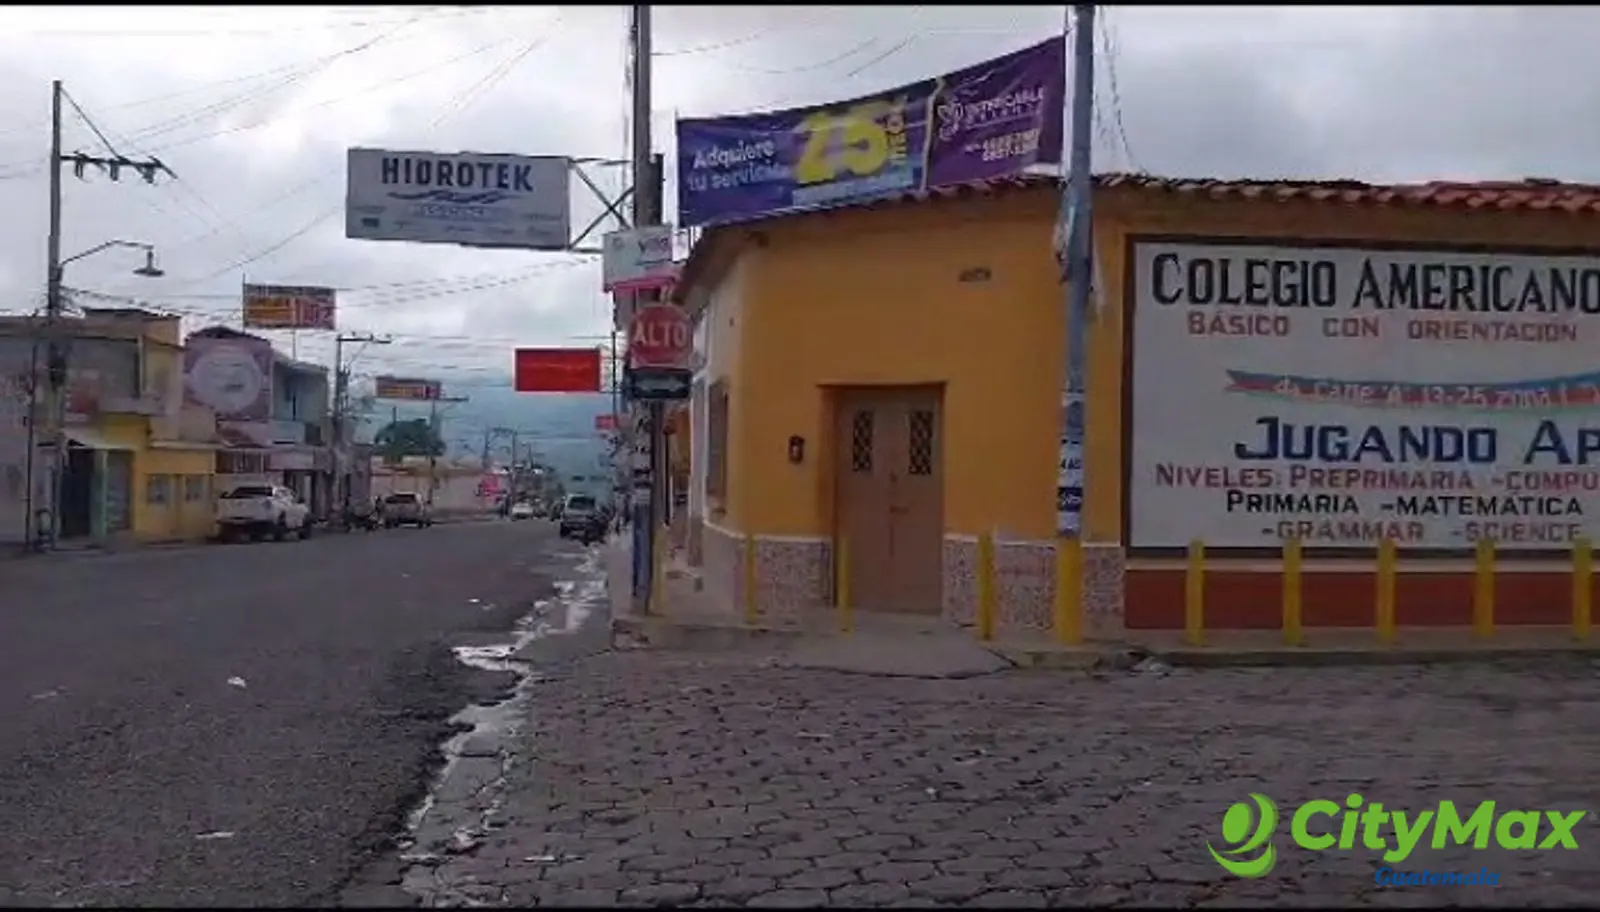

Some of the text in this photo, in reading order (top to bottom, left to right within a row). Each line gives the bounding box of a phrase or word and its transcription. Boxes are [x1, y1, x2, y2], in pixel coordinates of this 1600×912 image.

[692, 139, 776, 168] Adquiere
[795, 103, 890, 184] 25
[381, 157, 534, 192] HIDROTEK
[1152, 252, 1600, 314] COLEGIO AMERICANO
[634, 322, 688, 347] ALTO
[1322, 317, 1380, 338] CON
[1234, 415, 1600, 465] JUGANDO AP
[1289, 464, 1475, 491] PREPRIMARIA
[1226, 488, 1360, 514] PRIMARIA
